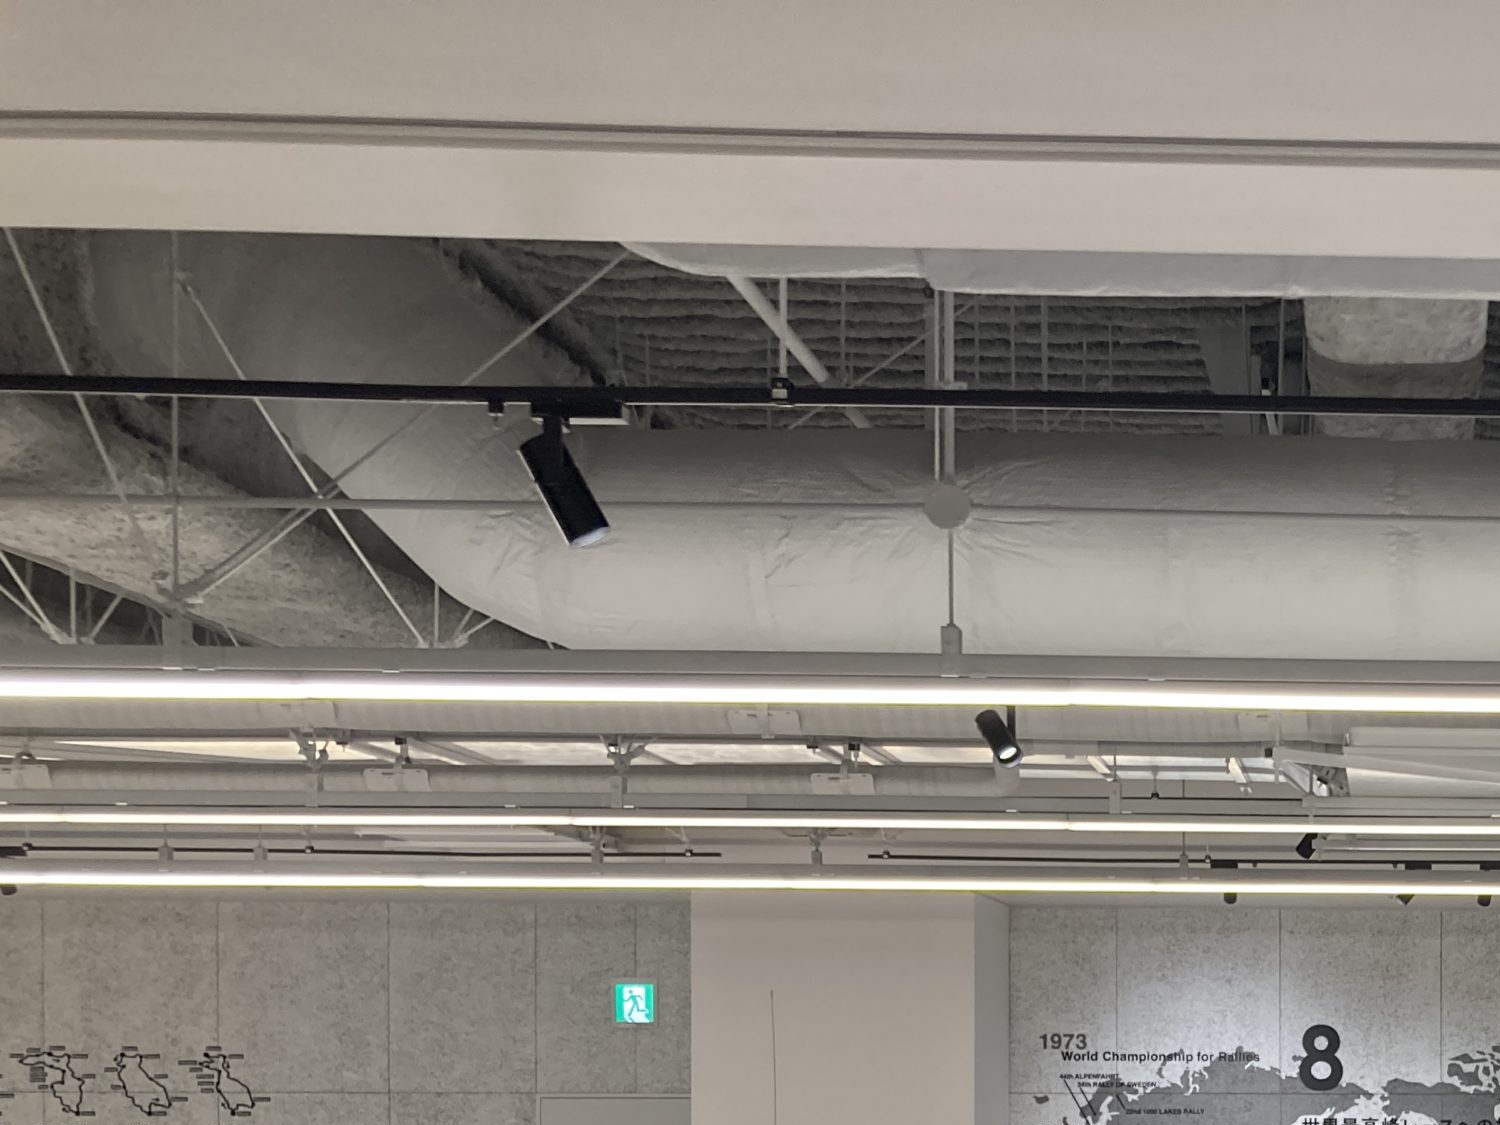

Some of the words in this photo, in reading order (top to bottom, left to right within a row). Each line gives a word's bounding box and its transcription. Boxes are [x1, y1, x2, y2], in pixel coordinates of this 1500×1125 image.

[1039, 1033, 1087, 1050] 1973
[1061, 1051, 1098, 1062] World
[1102, 1051, 1193, 1064] Championship
[1197, 1051, 1214, 1062] for
[1218, 1051, 1260, 1062] Rallies
[1300, 1024, 1343, 1091] 8
